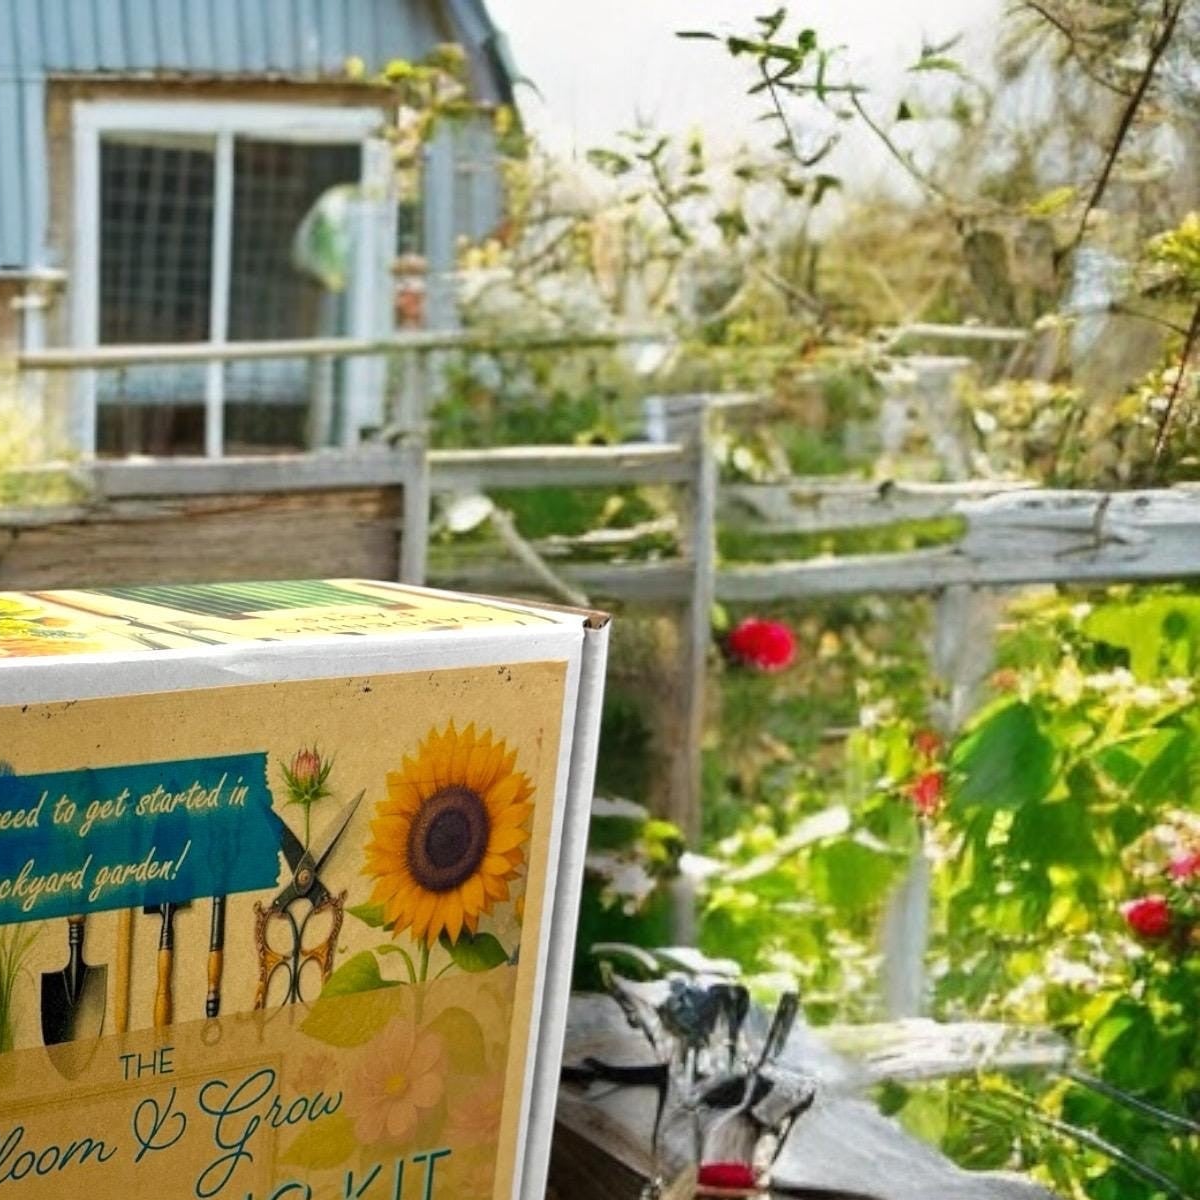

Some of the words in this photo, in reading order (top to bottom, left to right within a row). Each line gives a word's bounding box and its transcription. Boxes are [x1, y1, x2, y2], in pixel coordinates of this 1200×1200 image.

[54, 793, 76, 825] to
[84, 794, 129, 838] get
[136, 781, 220, 816] started
[227, 773, 249, 809] in
[94, 840, 191, 899] garden!
[120, 1048, 173, 1082] THE
[132, 1086, 185, 1164] &
[198, 1068, 345, 1199] Grow
